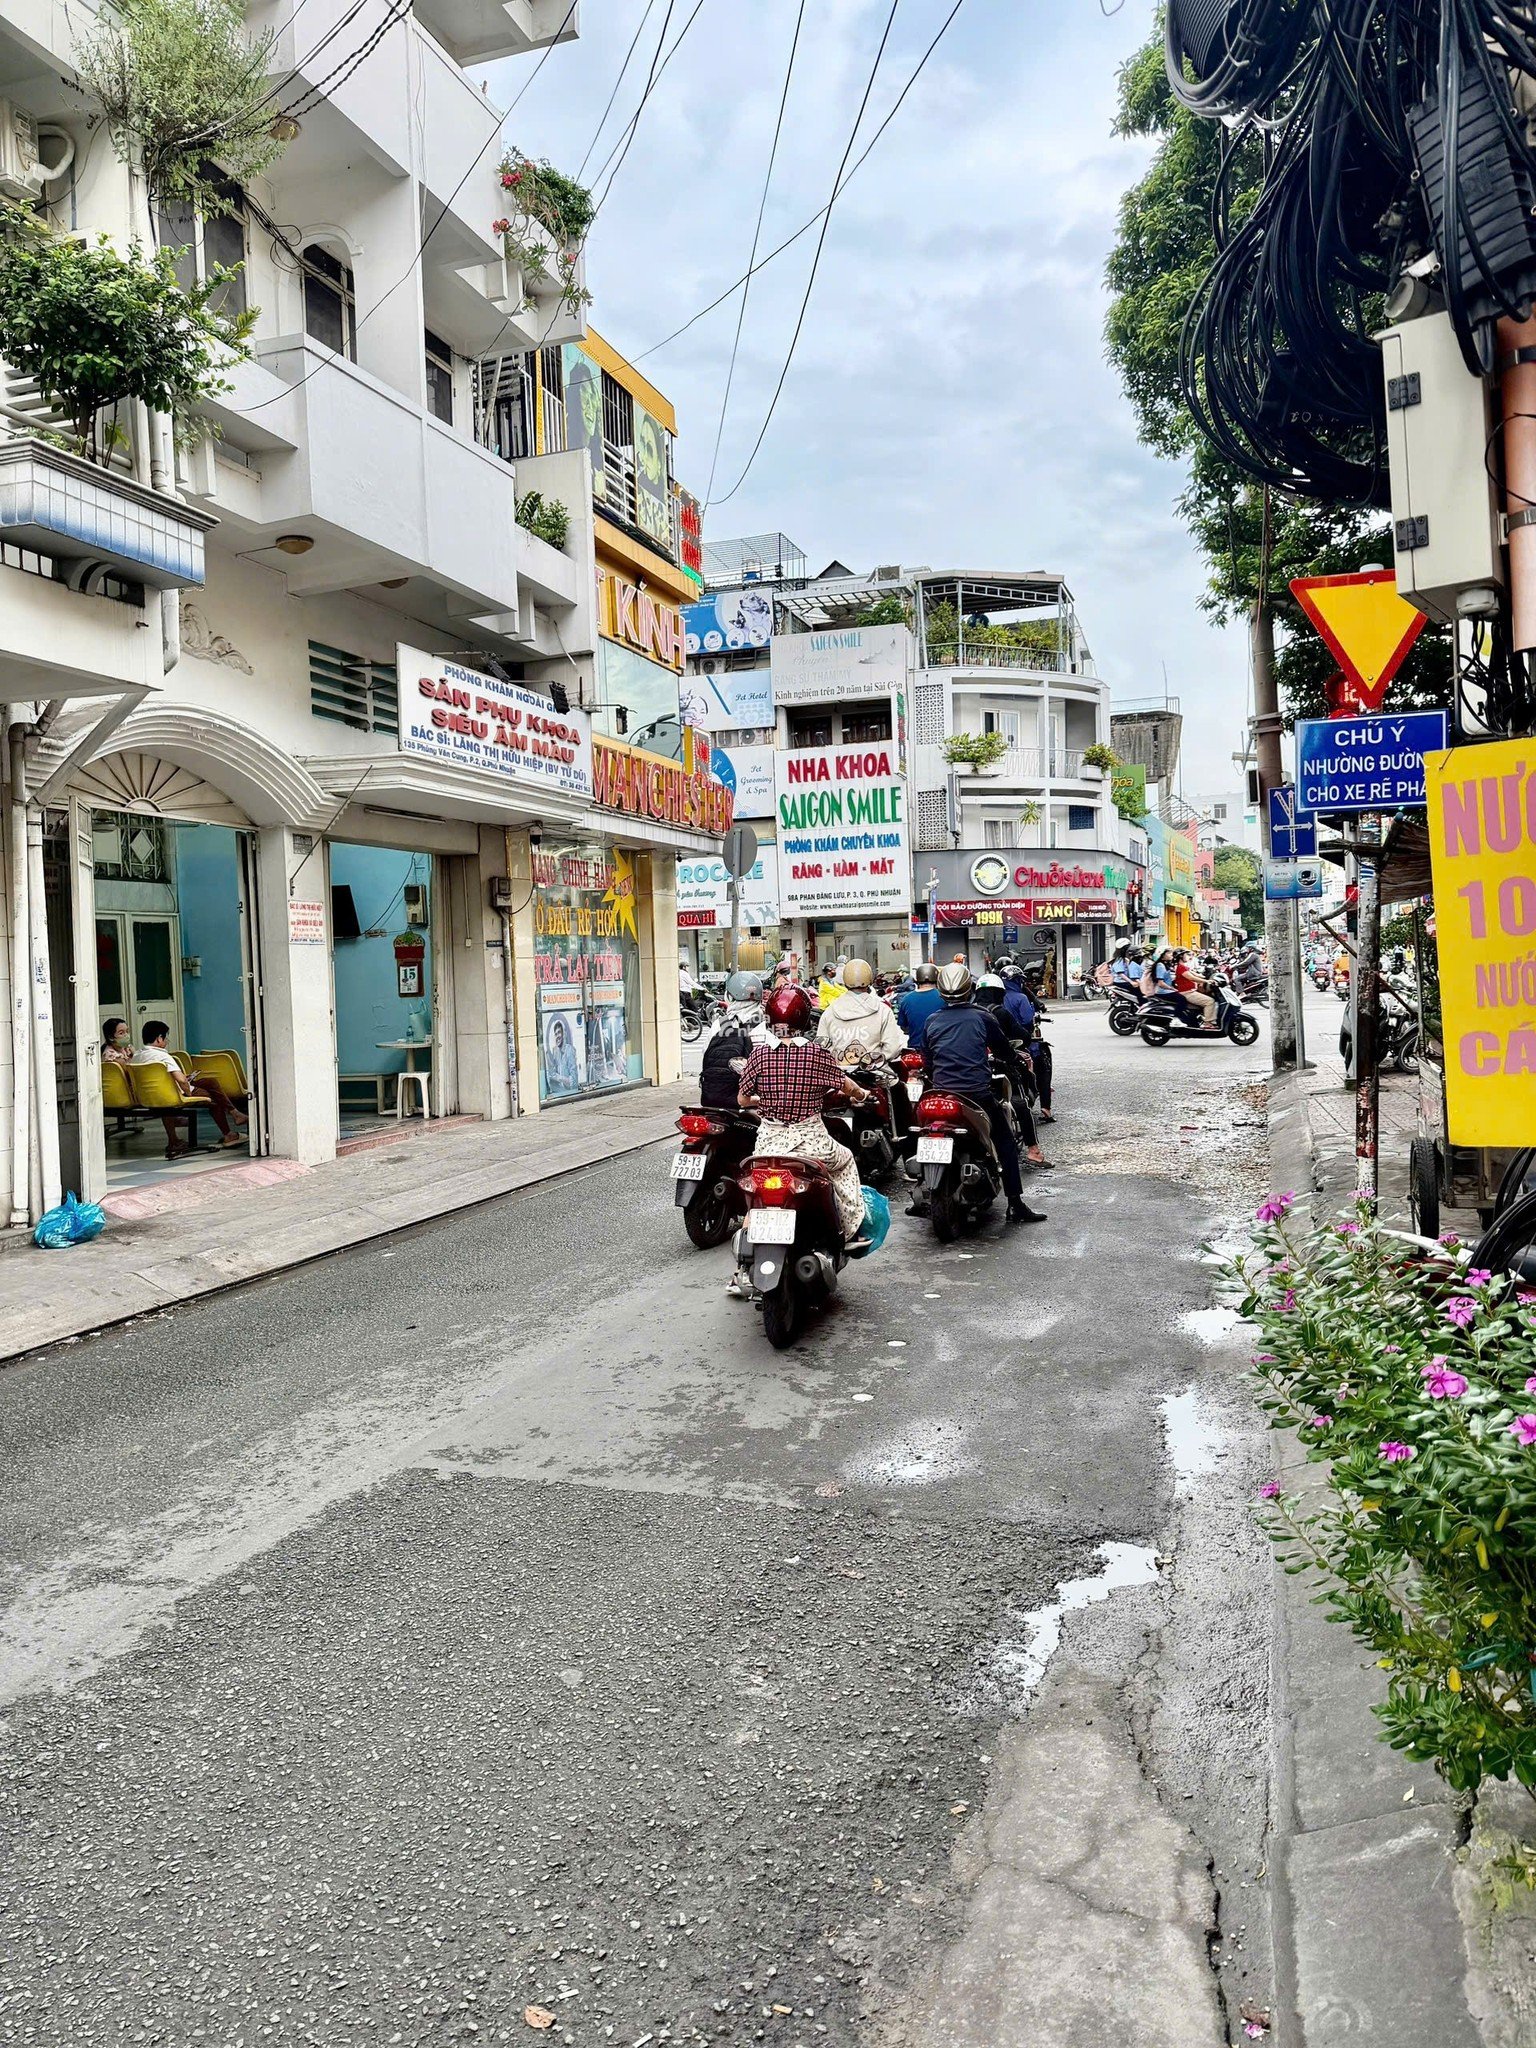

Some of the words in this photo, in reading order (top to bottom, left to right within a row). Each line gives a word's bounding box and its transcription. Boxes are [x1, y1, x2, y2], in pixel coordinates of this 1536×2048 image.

[612, 572, 686, 669] KÍNH
[444, 665, 482, 687] PHÒNG
[484, 679, 513, 698] KHÁM
[516, 690, 545, 708] NGOÀI
[820, 687, 835, 696] trên
[836, 686, 845, 694] 20
[846, 685, 861, 693] năm
[863, 683, 873, 694] tại
[418, 677, 471, 710] SẢN
[475, 696, 522, 731] PHỤ
[526, 713, 581, 746] KHOA
[431, 708, 488, 740] SIÊU
[493, 724, 528, 752] ÂM
[532, 740, 575, 764] MÀU
[1390, 719, 1406, 742] Ý
[403, 740, 416, 750] 135
[438, 748, 451, 758] Văn
[411, 724, 434, 742] BÁC
[436, 731, 451, 746] SĨ:
[453, 736, 481, 755] LĂNG
[483, 744, 500, 761] THỊ
[502, 749, 521, 764] HỮU
[523, 756, 544, 772] HIỆP
[545, 762, 559, 775] (BV
[573, 768, 587, 784] DŨ)
[788, 757, 830, 783] NHA
[836, 752, 891, 780] KHOA
[1304, 751, 1375, 776] NHƯỜNG
[592, 744, 734, 832] MANCHESTER
[1307, 786, 1340, 803] CHO
[1344, 784, 1366, 801] XE
[1370, 777, 1392, 800] RẼ
[779, 789, 842, 830] SAIGON
[847, 786, 902, 827] SMILE
[784, 837, 812, 853] PHÒNG
[814, 835, 839, 852] KHÁM
[841, 832, 875, 850] CHUYÊN
[877, 832, 901, 848] KHOA
[792, 862, 822, 879] RĂNG
[833, 859, 858, 877] HÀM
[679, 914, 700, 926] QUA
[975, 910, 1003, 925] 199K
[1036, 902, 1072, 921] TẶNG
[402, 968, 416, 980] 15
[535, 943, 563, 983] TRẢ
[672, 1166, 701, 1178] 727.03
